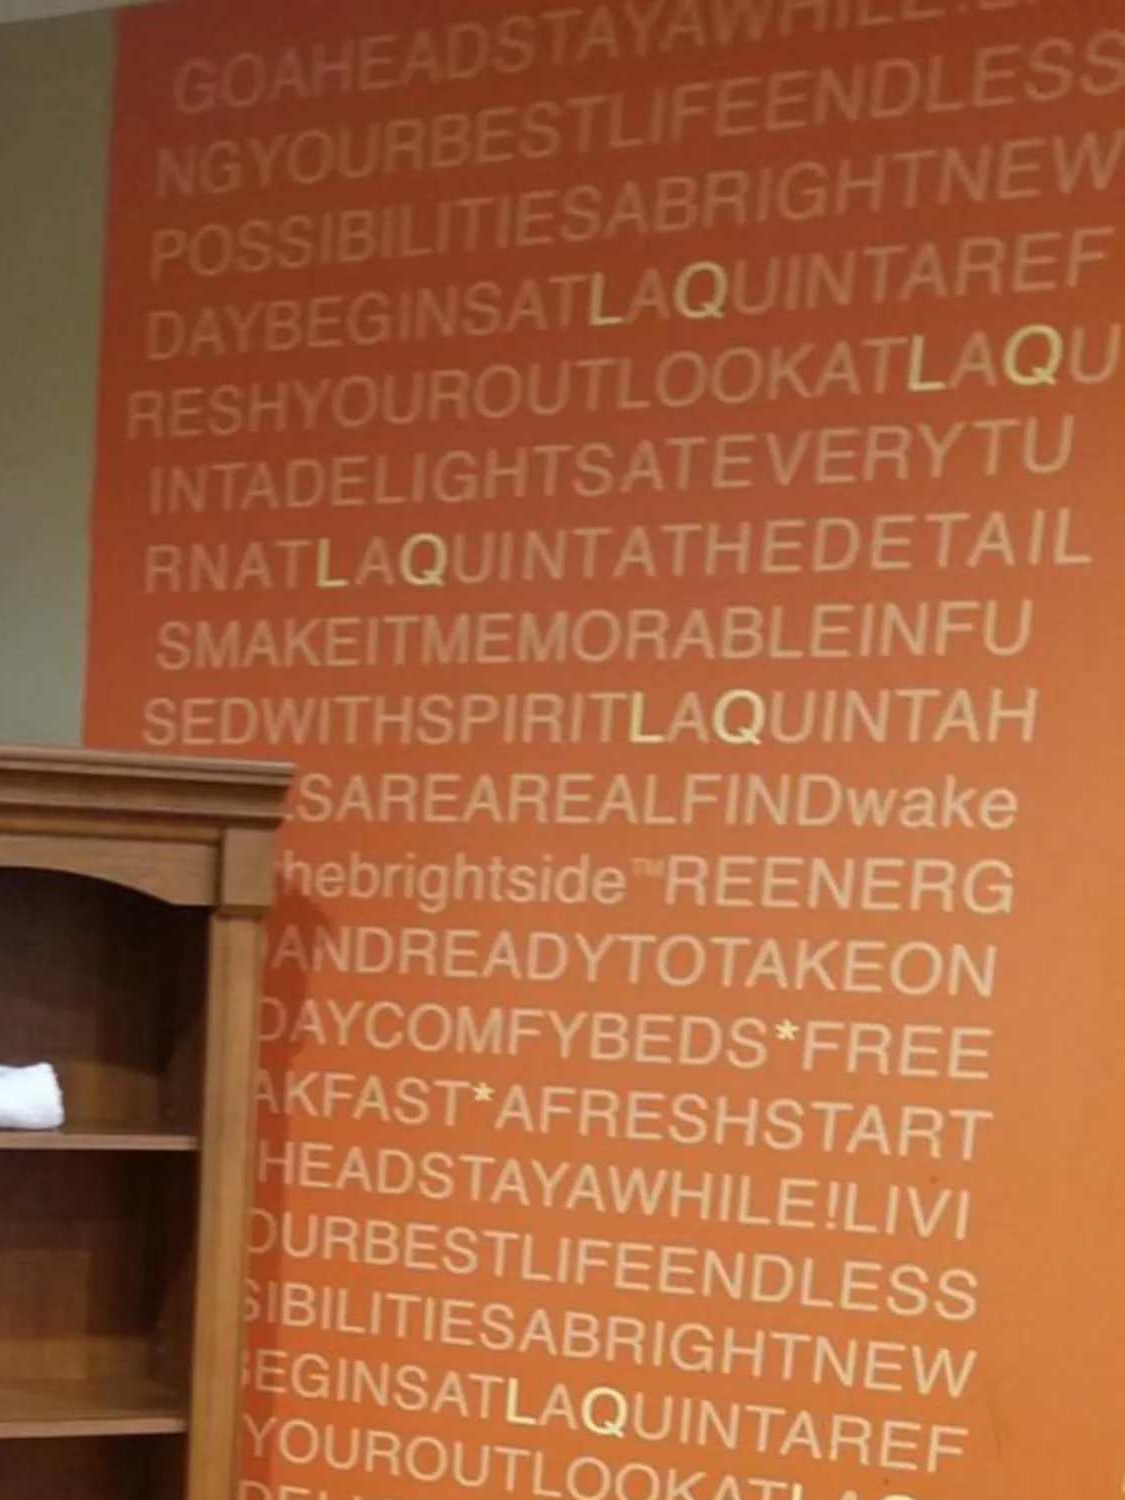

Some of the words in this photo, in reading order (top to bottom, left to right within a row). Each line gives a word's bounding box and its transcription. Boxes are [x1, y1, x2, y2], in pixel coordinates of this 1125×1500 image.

[284, 772, 1019, 830] SAREAREALFINDwake
[263, 924, 998, 998] ANDREADYTOTAKEON
[242, 1349, 969, 1474] EGINSATLAQUINTAREF
